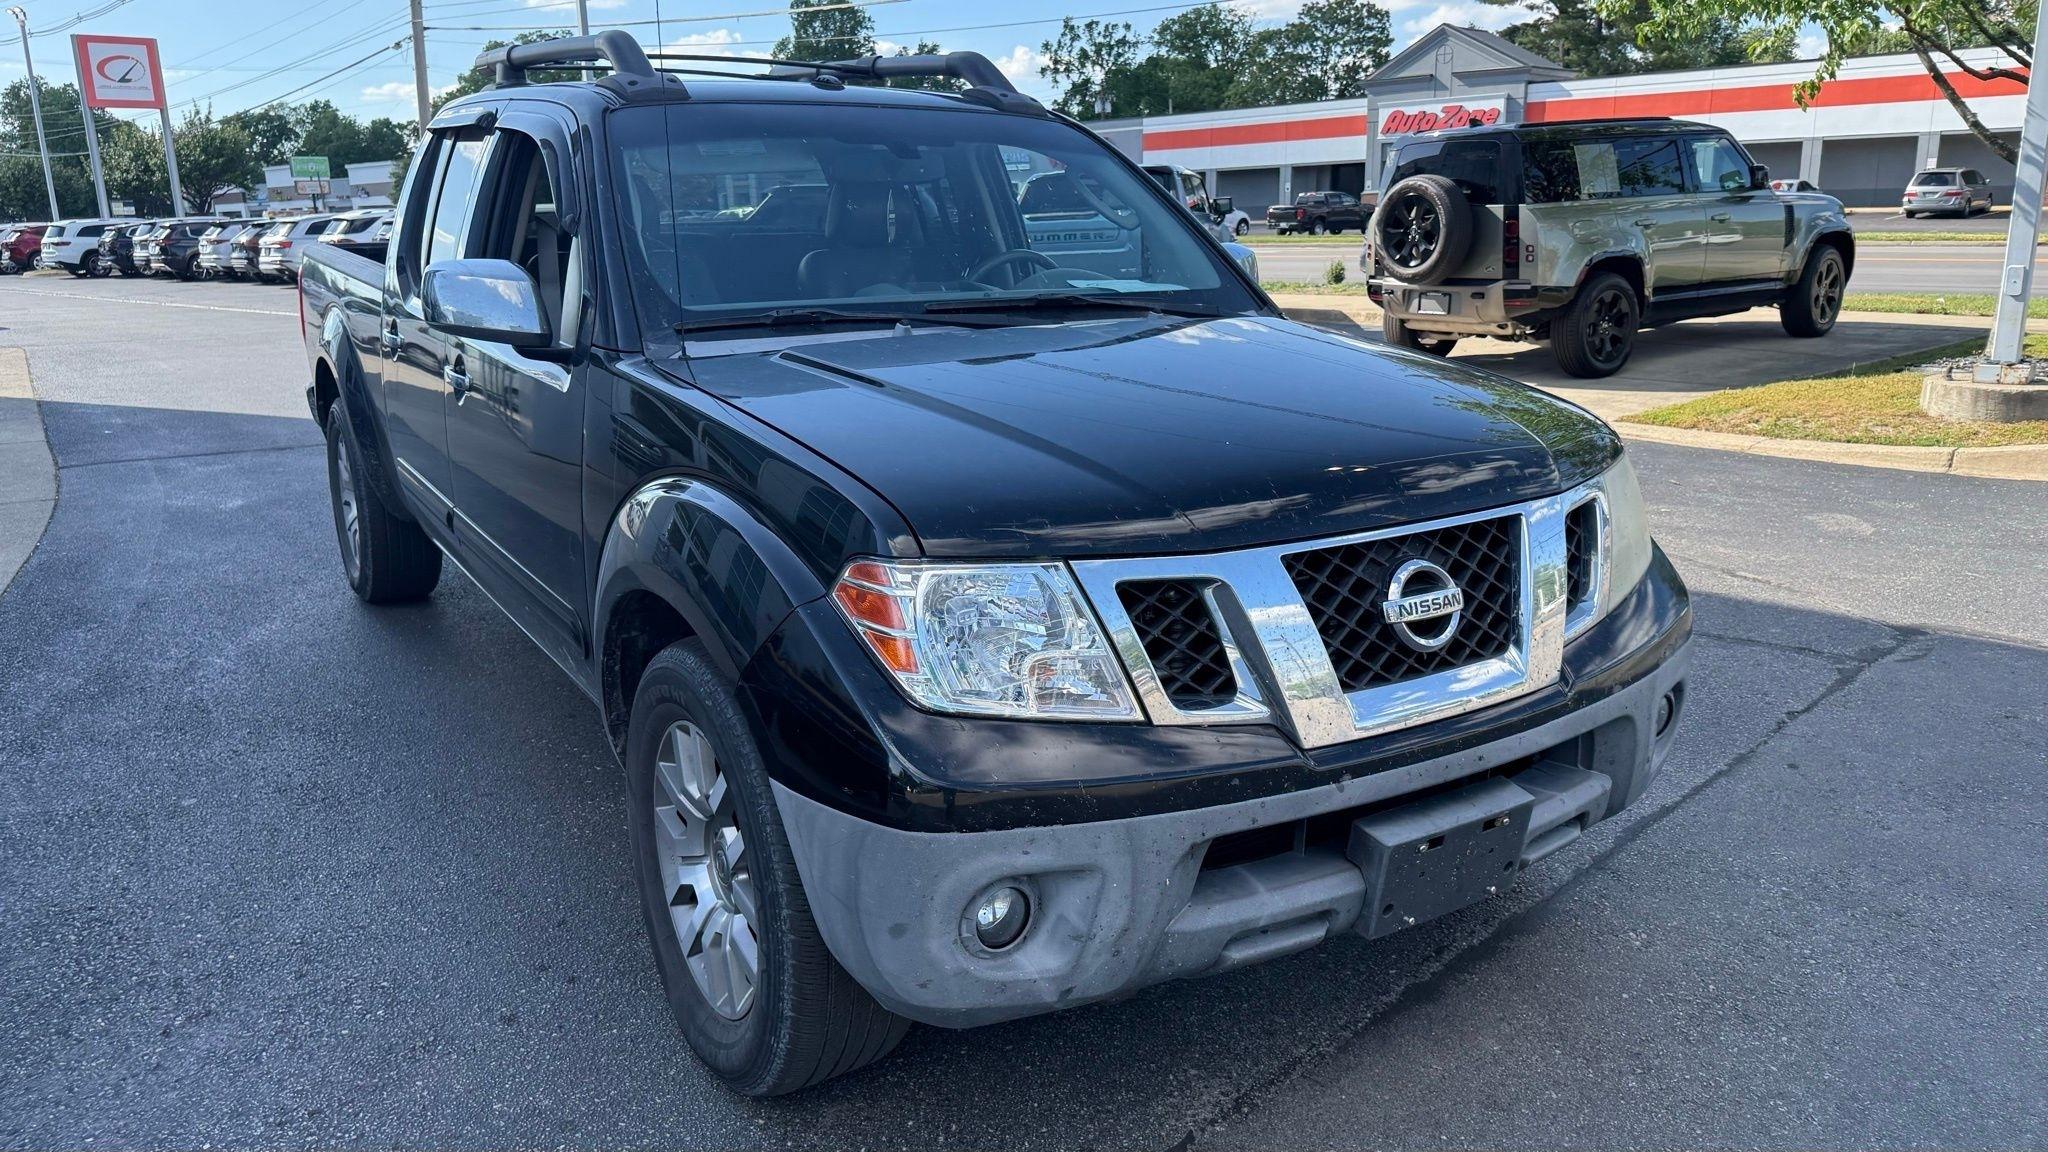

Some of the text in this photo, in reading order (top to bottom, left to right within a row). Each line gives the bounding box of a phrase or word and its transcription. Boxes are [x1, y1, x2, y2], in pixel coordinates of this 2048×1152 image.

[1380, 105, 1501, 135] AutoZone
[1032, 232, 1105, 241] UMMER
[1398, 592, 1461, 618] NISSAN
